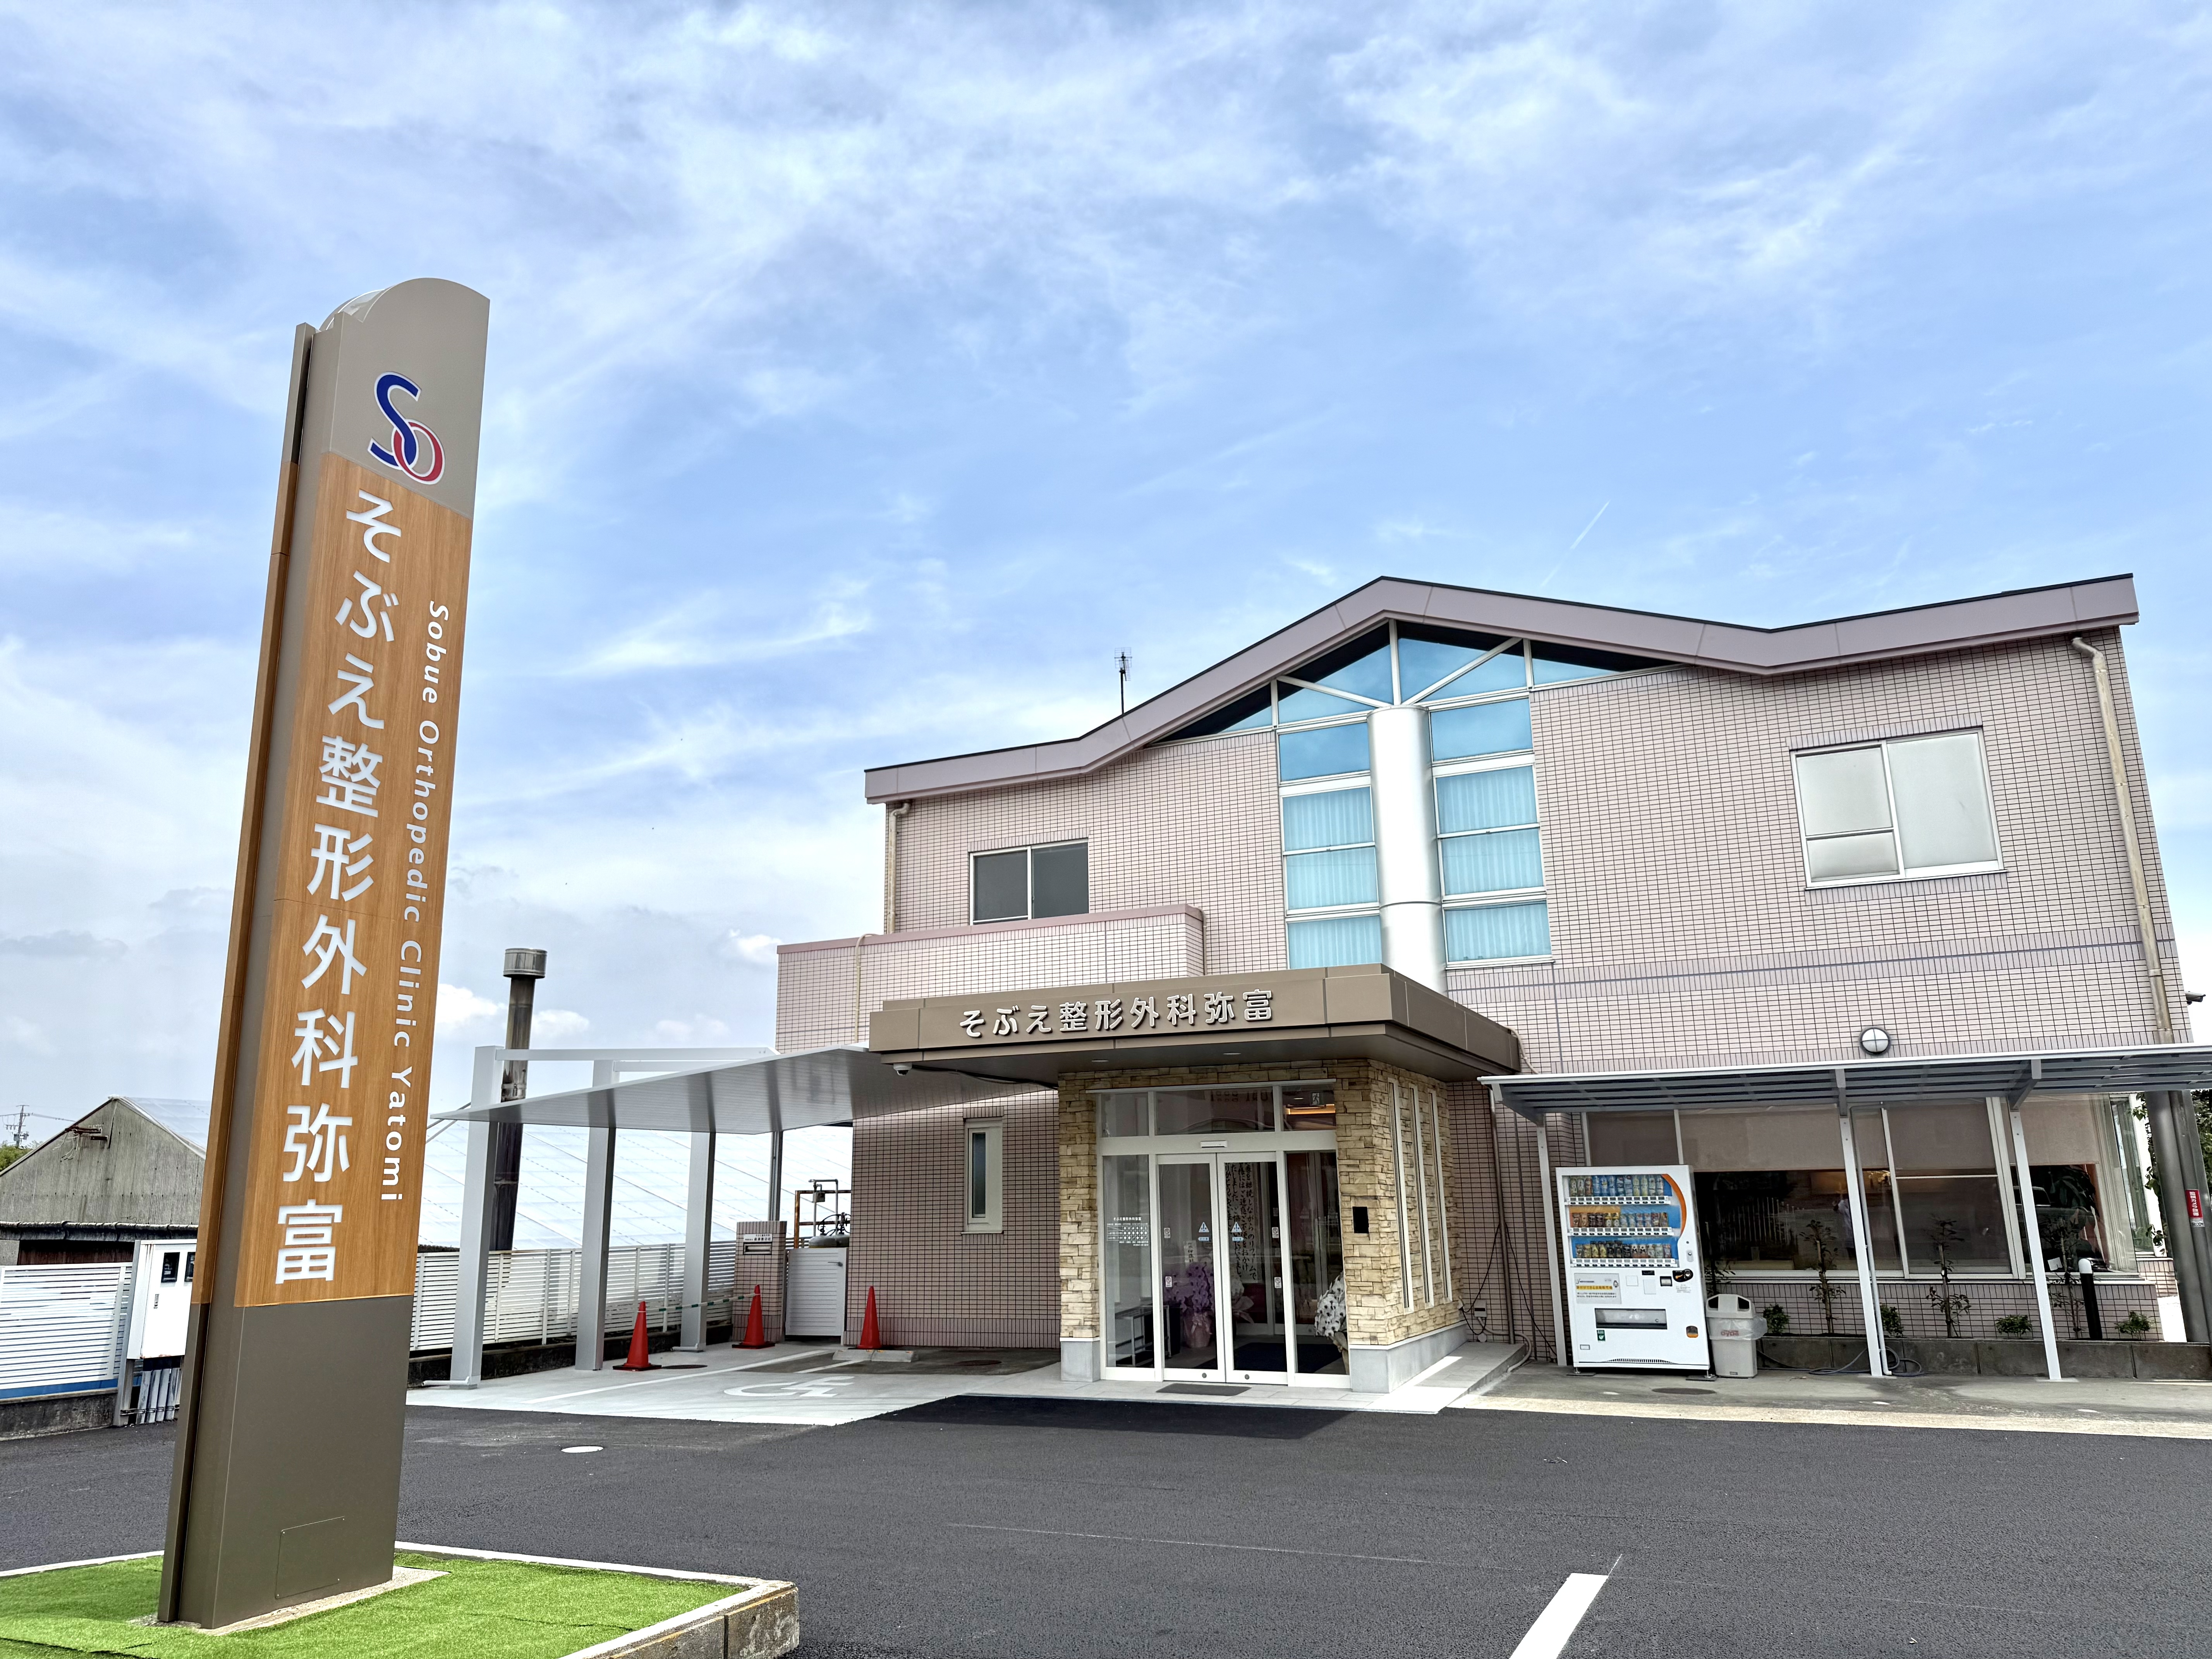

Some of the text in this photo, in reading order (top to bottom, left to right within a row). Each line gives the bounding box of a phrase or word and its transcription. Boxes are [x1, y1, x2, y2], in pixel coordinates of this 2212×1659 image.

[275, 489, 401, 1284] そぶえ整形外科弥富
[381, 600, 449, 1200] Sobue Orthopedic Clinic Yatomi
[960, 988, 1273, 1038] そぶえ整形外科弥富
